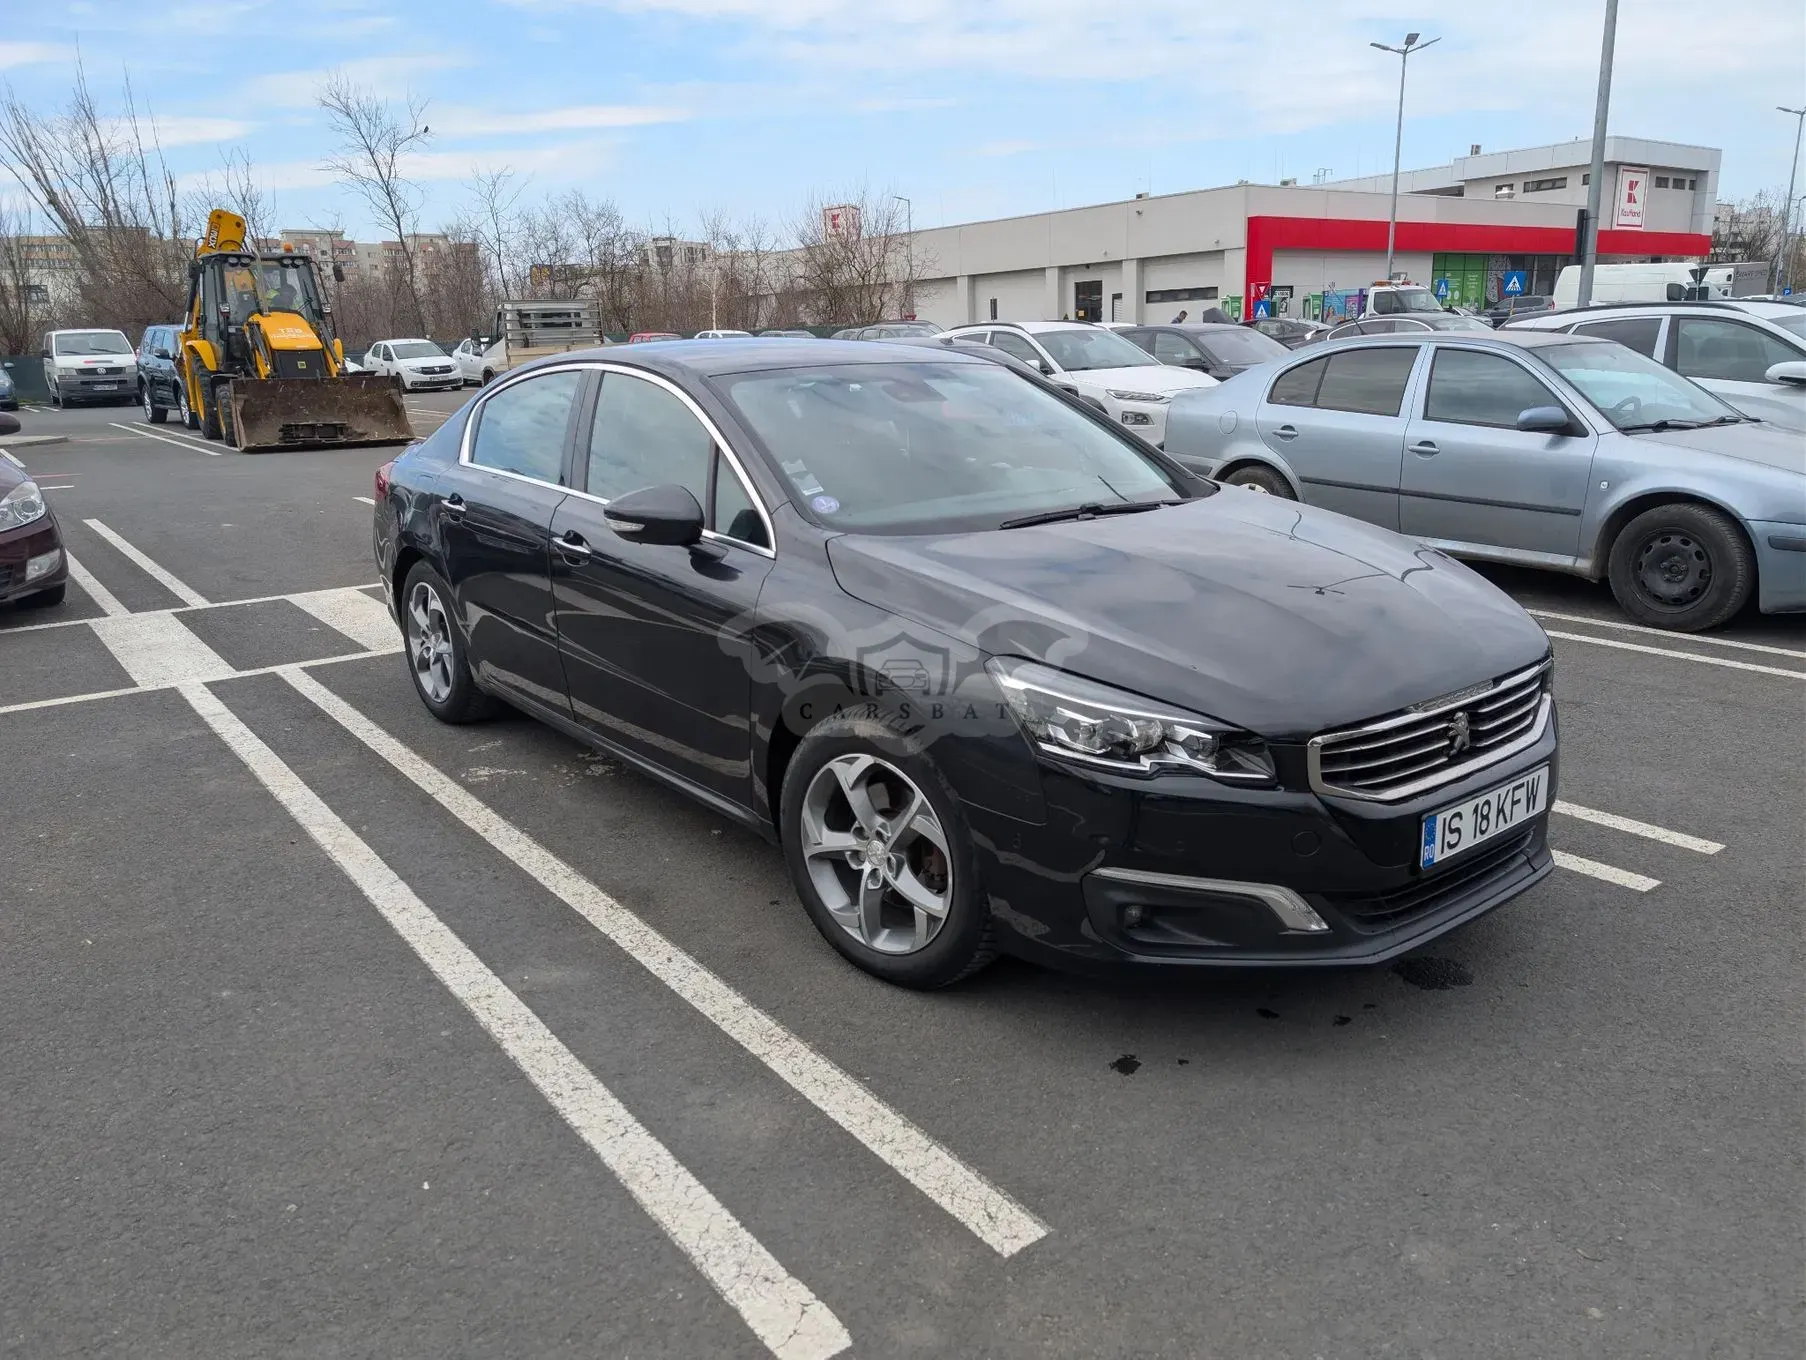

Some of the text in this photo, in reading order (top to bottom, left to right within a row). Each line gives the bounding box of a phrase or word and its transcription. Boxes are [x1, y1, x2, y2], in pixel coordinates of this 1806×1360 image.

[1627, 180, 1640, 204] K
[1620, 208, 1641, 218] Kaufland
[1441, 774, 1541, 854] IS 18 KFW
[1423, 843, 1434, 861] RO
